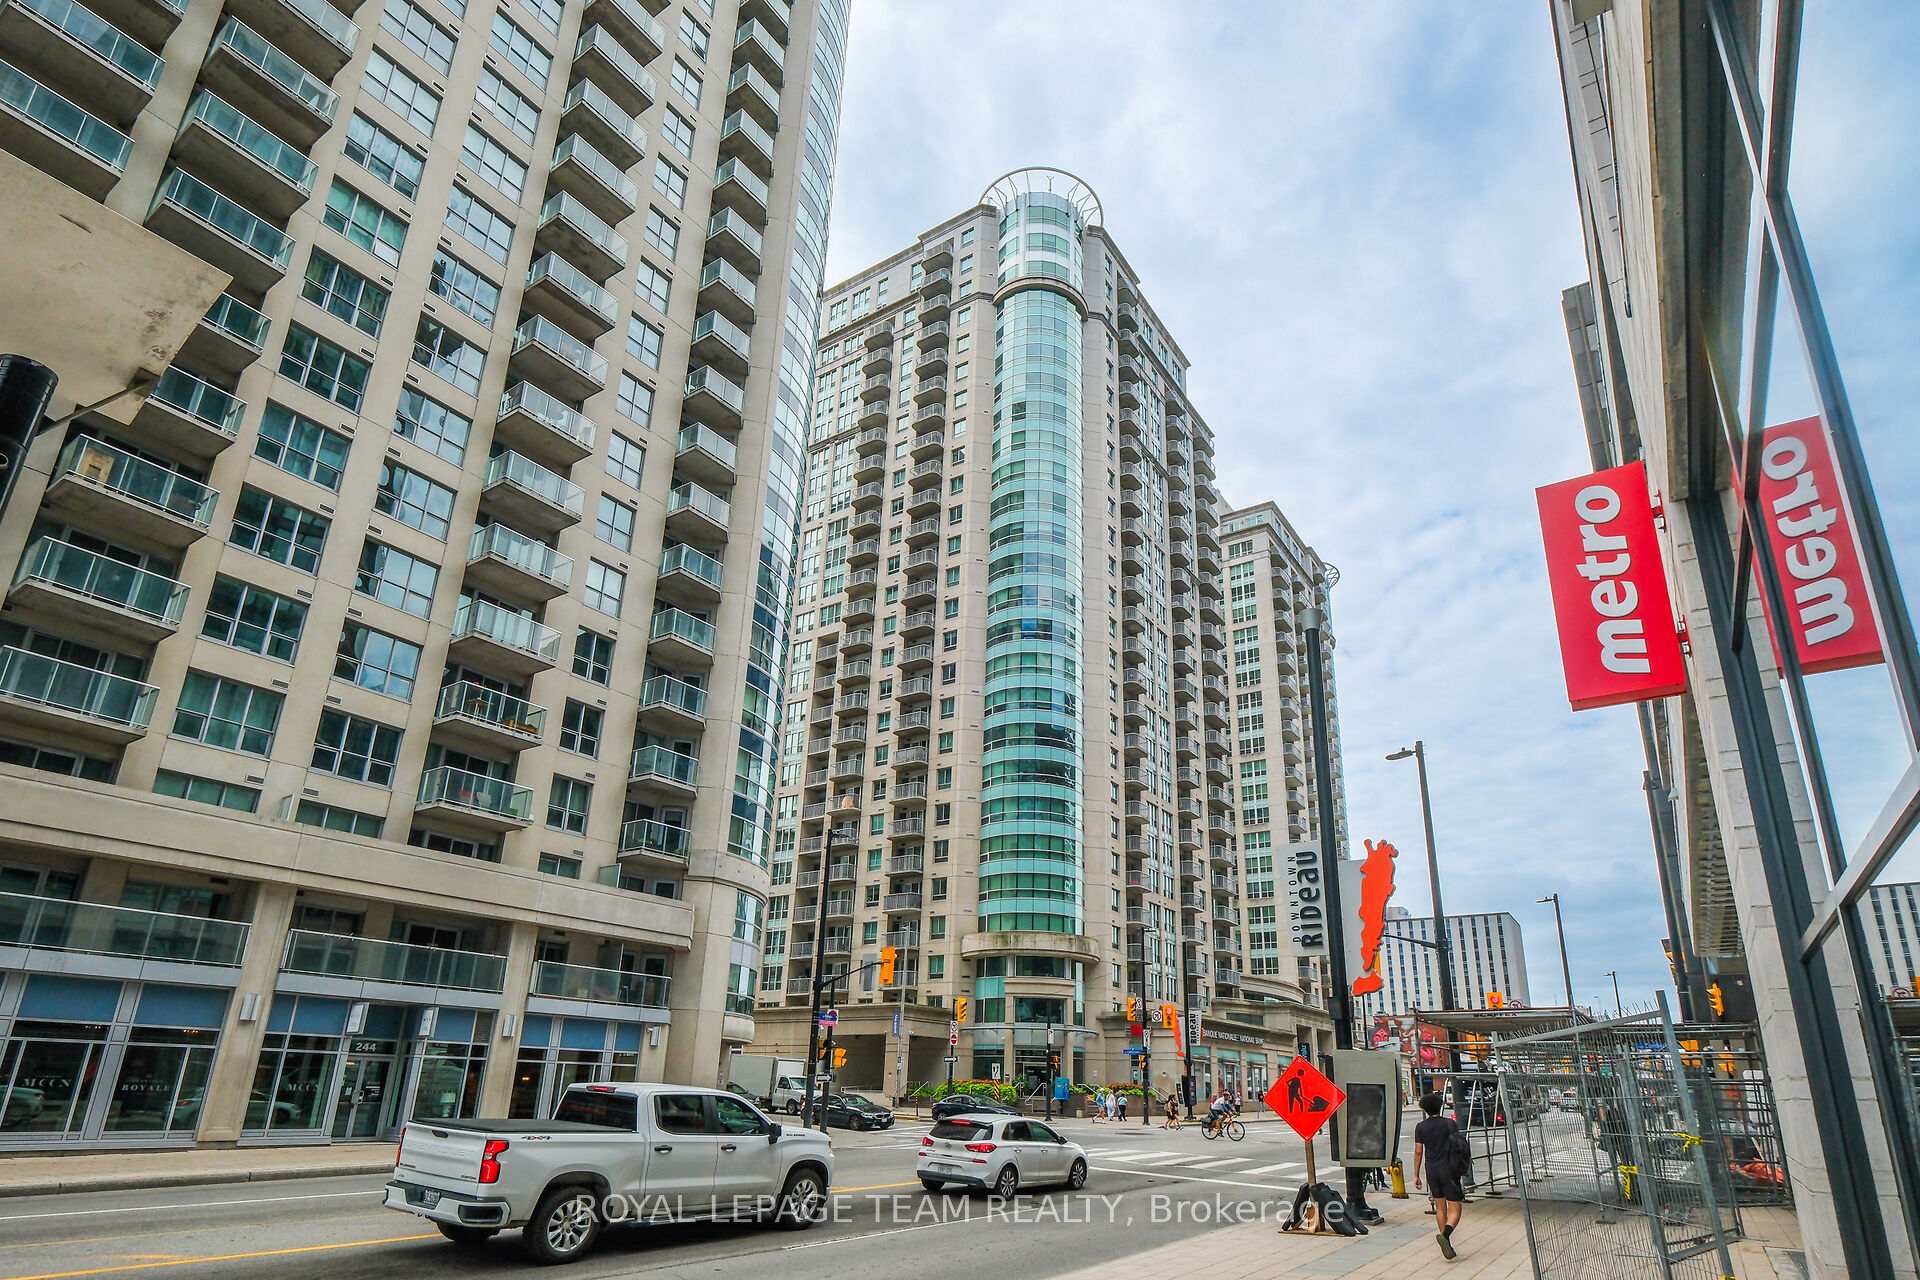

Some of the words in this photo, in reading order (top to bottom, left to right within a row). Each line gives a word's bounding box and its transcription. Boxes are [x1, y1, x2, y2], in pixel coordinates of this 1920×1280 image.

[1574, 485, 1651, 673] metro
[1288, 856, 1302, 943] DOWNTOWN
[355, 1042, 376, 1053] 244
